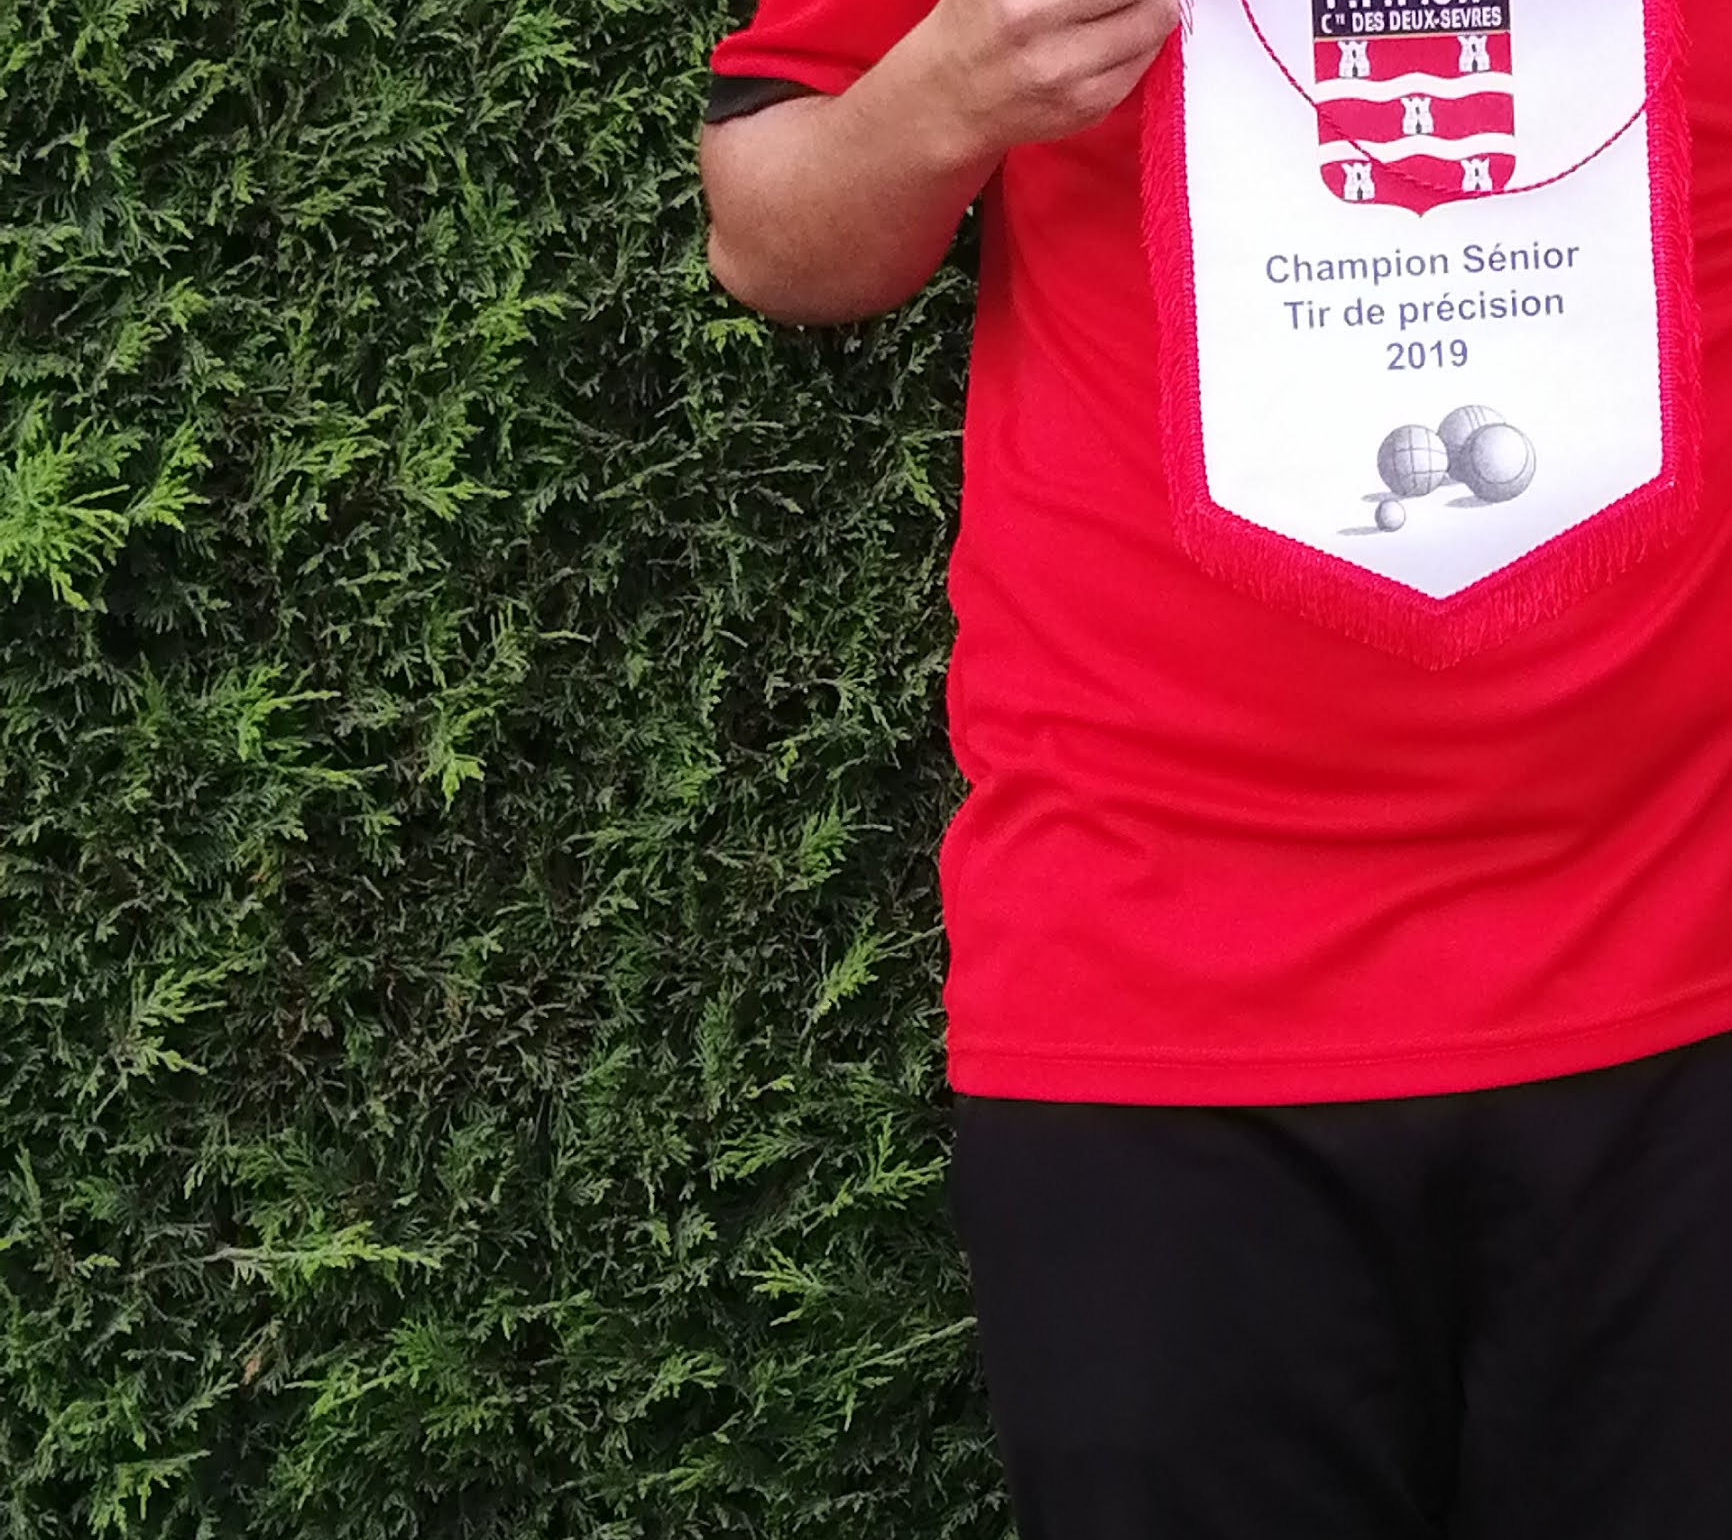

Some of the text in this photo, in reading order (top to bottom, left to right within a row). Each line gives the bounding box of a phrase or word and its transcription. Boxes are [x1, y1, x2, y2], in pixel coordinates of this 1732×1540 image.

[1352, 12, 1385, 33] DES
[1266, 242, 1580, 286] Champion Sénior
[1284, 290, 1565, 331] Tir de précision
[1386, 339, 1469, 370] 2019
